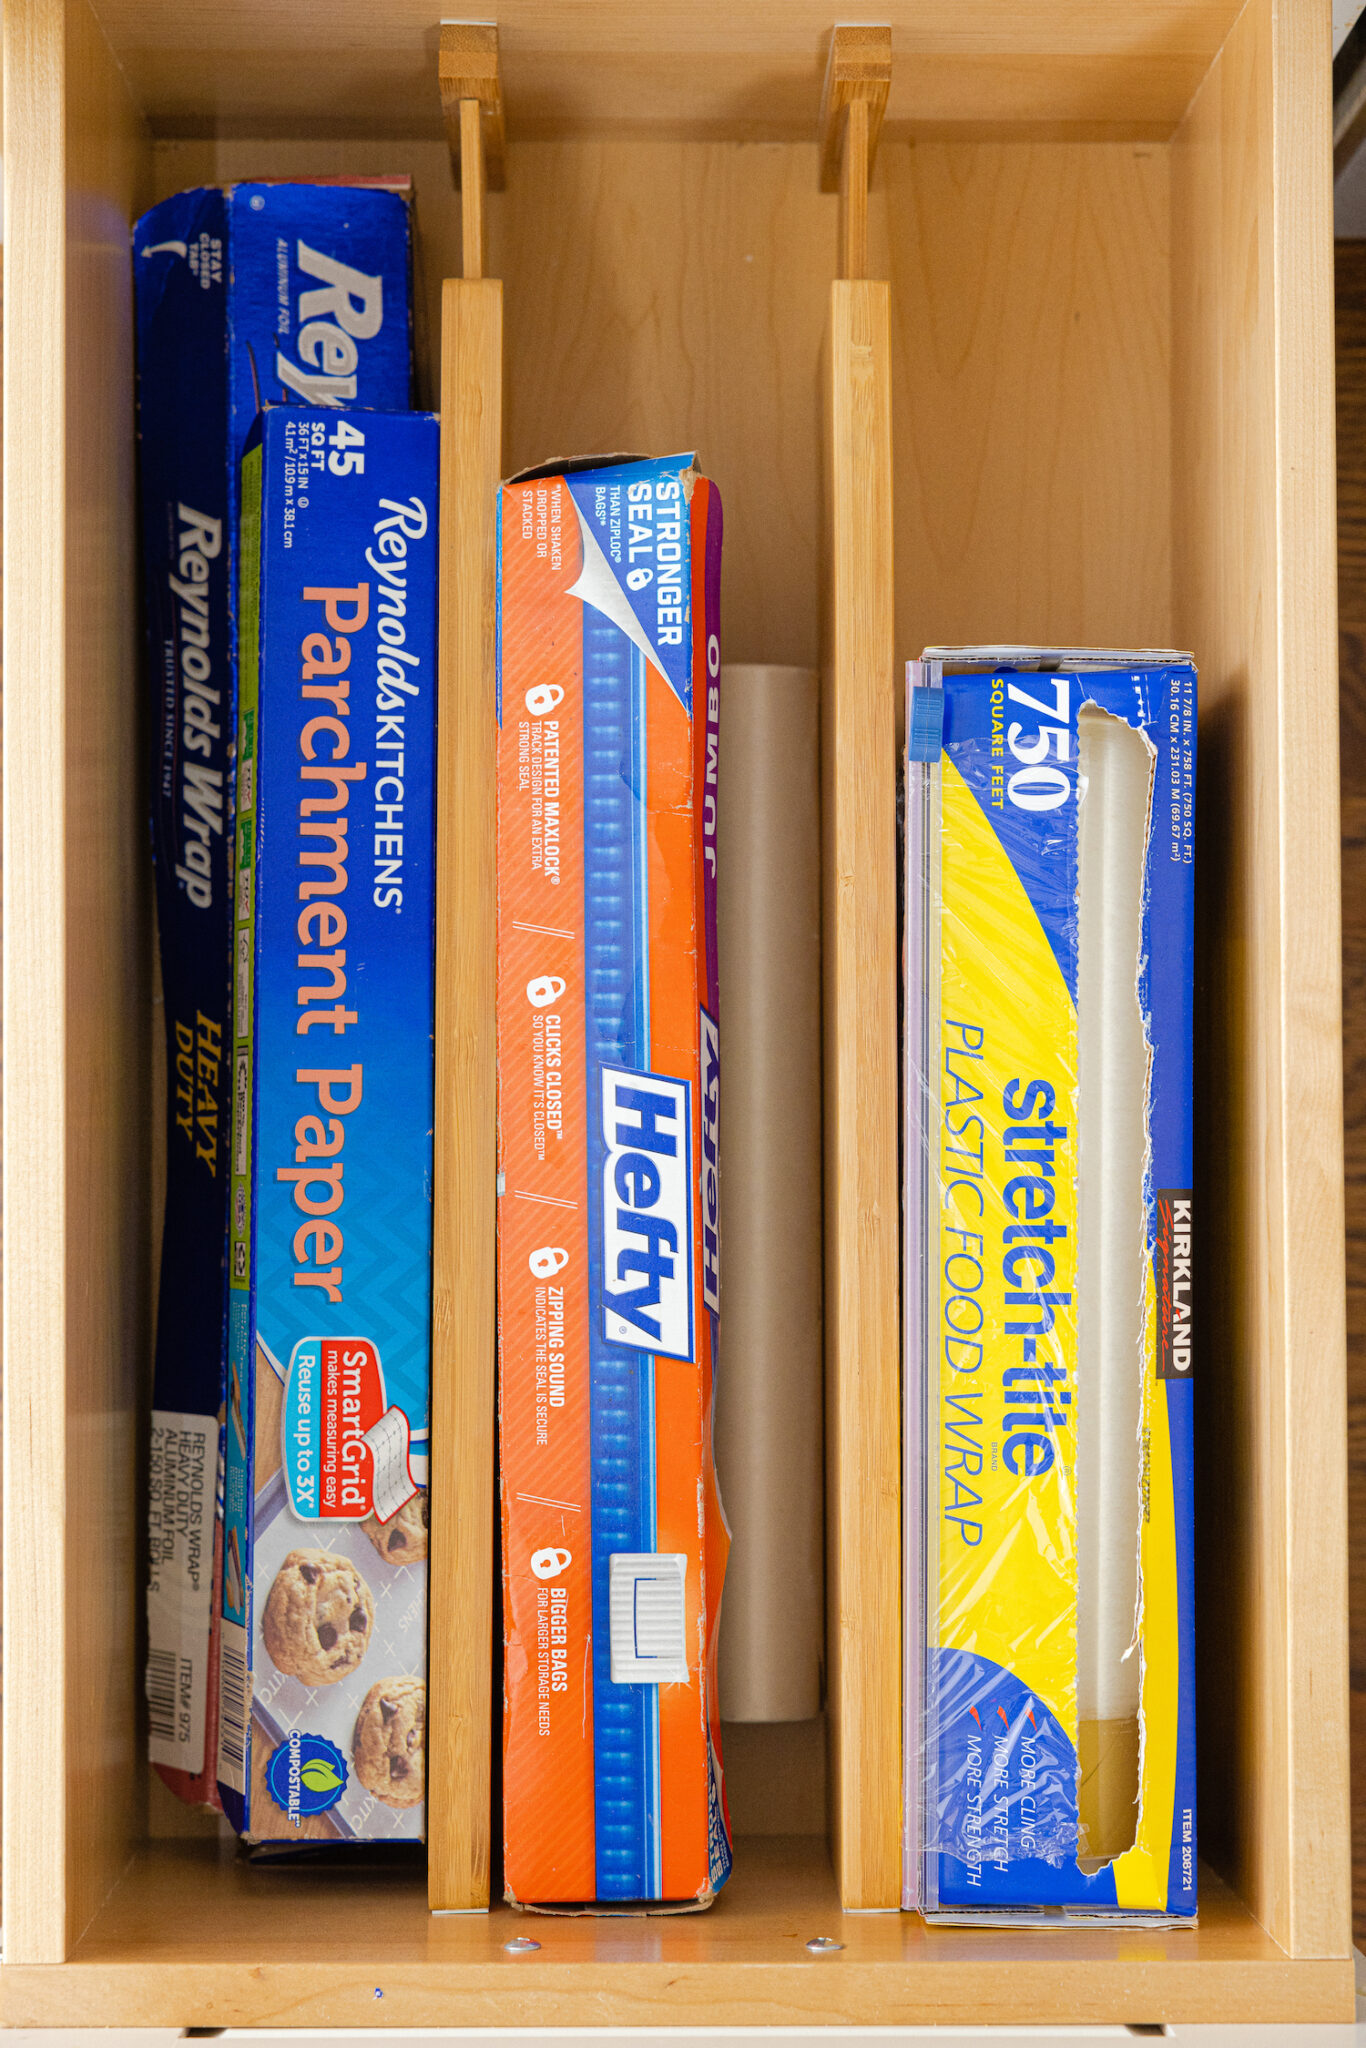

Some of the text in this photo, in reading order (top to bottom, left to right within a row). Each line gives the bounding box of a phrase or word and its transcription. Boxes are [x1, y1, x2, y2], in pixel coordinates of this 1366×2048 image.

[200, 233, 210, 289] CLOSED
[210, 239, 222, 283] STAY
[277, 238, 290, 334] ALUMINUM FOIL
[285, 421, 296, 436] 4.1
[298, 421, 309, 436] 36
[298, 437, 309, 452] FT
[311, 422, 325, 471] SQ FT
[328, 420, 365, 476] 45
[285, 463, 295, 484] 10.9
[285, 485, 293, 496] m
[298, 462, 309, 475] 15
[298, 477, 309, 489] IN
[284, 507, 295, 529] 38.1
[522, 490, 533, 540] STACKED
[537, 490, 547, 558] DROPPED OR
[610, 485, 621, 516] THAN
[627, 483, 653, 563] SEAL
[284, 531, 293, 548] cm
[551, 526, 562, 571] SHAKEN
[656, 481, 682, 645] STRONGER
[365, 496, 428, 711] Reynolds
[168, 503, 222, 908] Reynolds Wrap
[1170, 679, 1180, 710] 30.16
[1183, 681, 1193, 695] 11
[1183, 698, 1193, 716] 7/8
[162, 640, 175, 797] TRUSTED SINCE 1947
[990, 678, 1004, 810] SQUARE FEET
[1007, 678, 1071, 811] 750
[1170, 714, 1179, 733] CM
[1183, 720, 1193, 735] IN.
[519, 721, 530, 791] STRONG SEAL
[544, 720, 560, 797] PATENTED
[704, 634, 720, 879] JUMBO
[1170, 747, 1180, 785] 231.03
[1183, 750, 1193, 770] 758
[1183, 774, 1192, 789] FT.
[531, 721, 543, 870] TRACK DESIGN FOR AN EXTRA
[1170, 803, 1181, 838] (69.67
[1171, 788, 1180, 800] M
[1182, 792, 1193, 817] (750
[1182, 821, 1192, 840] SQ.
[1182, 844, 1193, 864] FT.)
[277, 582, 370, 1303] Parchment Paper
[533, 1014, 544, 1029] SO
[533, 1031, 544, 1052] YOU
[546, 1015, 562, 1067] CLICKS
[176, 1020, 194, 1141] DUTY
[196, 1009, 222, 1178] HEAVY
[533, 1054, 544, 1087] KNOW
[534, 1090, 545, 1108] IT'S
[704, 1028, 720, 1298] Hefty
[944, 1019, 984, 1547] PLASTIC FOOD WRAP
[1155, 1200, 1175, 1372] Signature
[1173, 1200, 1191, 1371] KIRKLAND
[535, 1286, 548, 1446] INDICATES THE SEAL IS SECURE
[548, 1286, 565, 1407] ZIPPING SOUND
[297, 1355, 315, 1414] Reuse
[293, 1419, 311, 1446] up
[323, 1350, 339, 1508] makes measuring easy
[176, 1430, 192, 1537] HEAVY DUTY
[190, 1432, 206, 1525] REYNOLDS
[297, 1449, 313, 1471] to
[162, 1428, 177, 1565] ALUMINUM FOIL
[537, 1587, 550, 1736] FOR LARGER STORAGE NEEDS
[550, 1588, 568, 1692] BIGGER BAGS
[178, 1658, 192, 1743] ITEM# 975
[966, 1734, 982, 1887] MORE STRENGTH
[994, 1735, 1009, 1872] MORE STRETCH
[1020, 1736, 1036, 1849] MORE CLING
[1182, 1809, 1192, 1891] ITEM 208721
